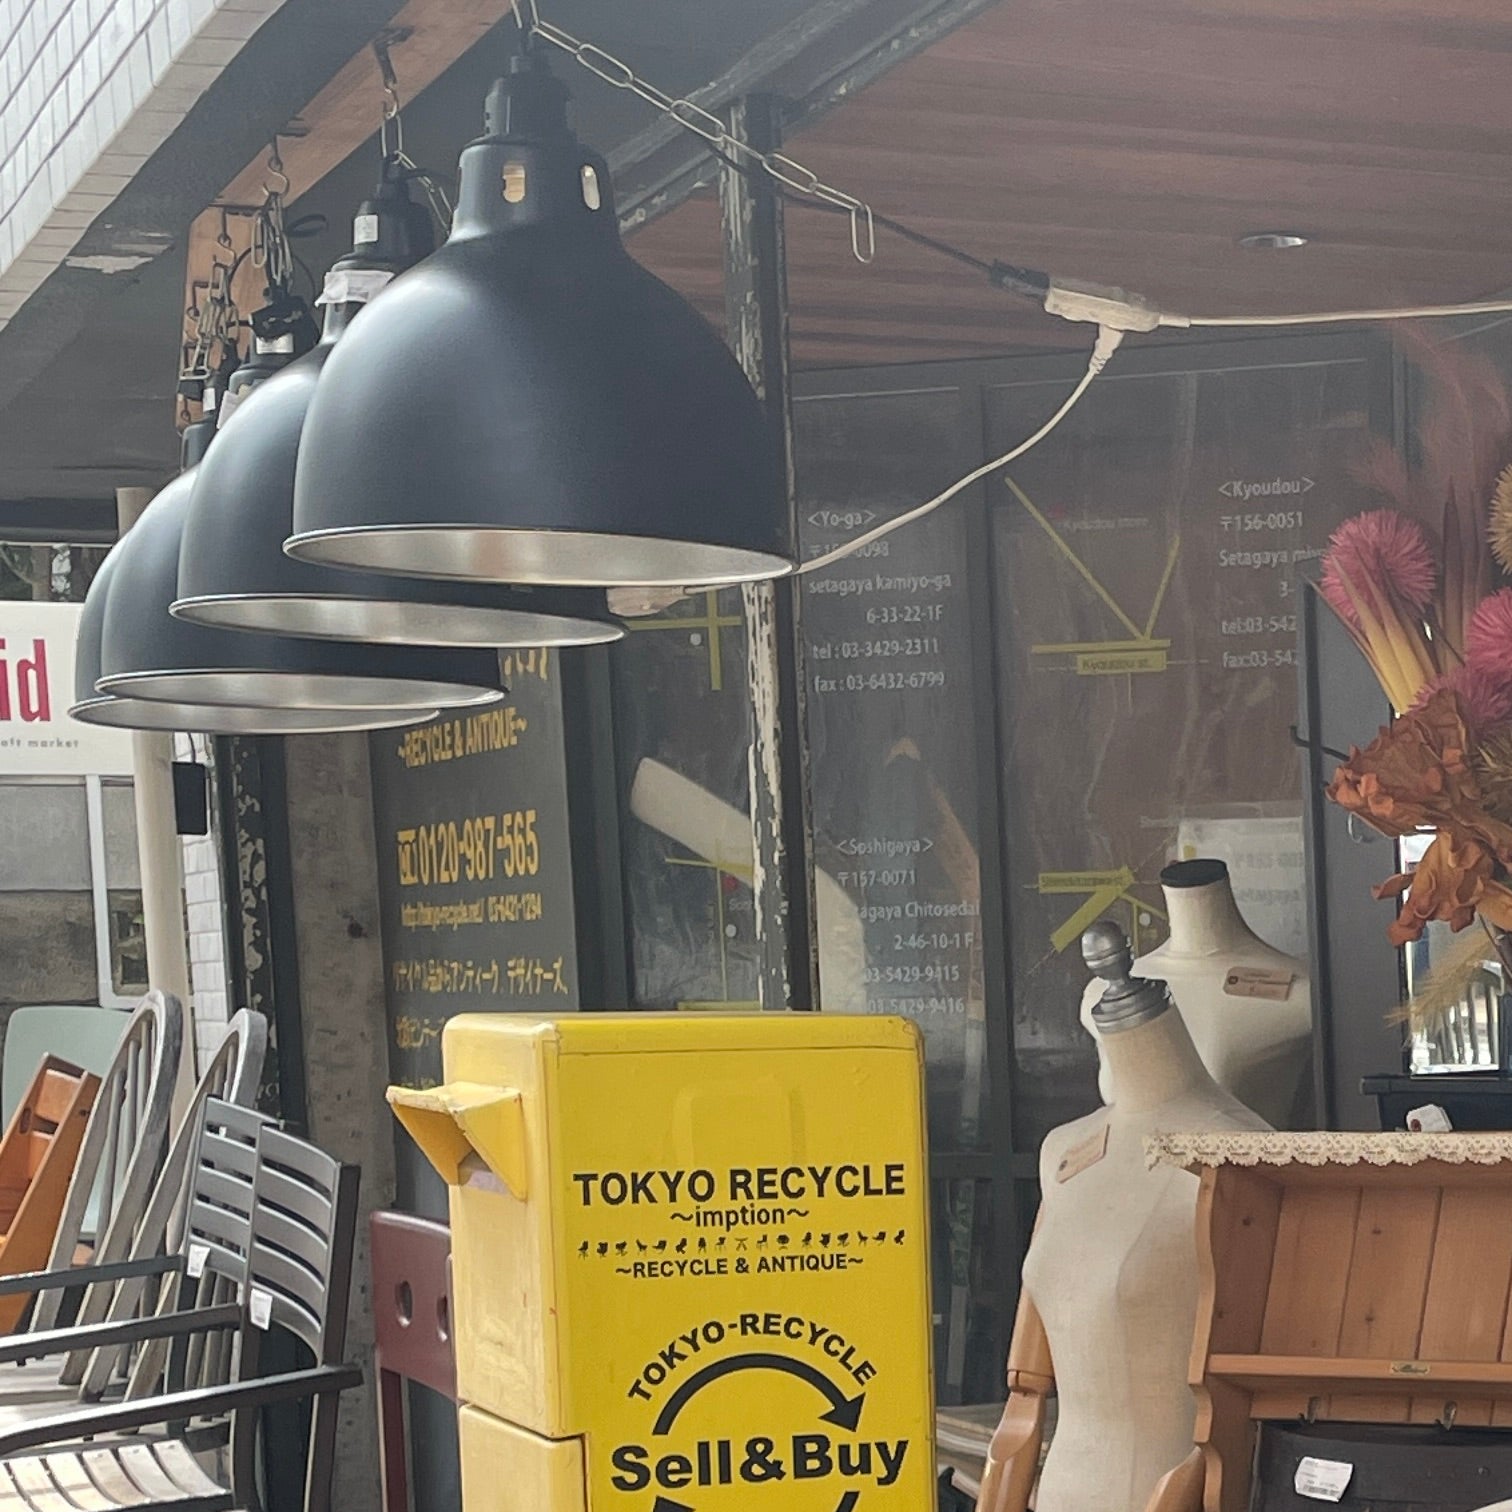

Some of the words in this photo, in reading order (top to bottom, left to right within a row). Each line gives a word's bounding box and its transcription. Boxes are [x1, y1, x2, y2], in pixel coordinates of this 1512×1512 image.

[809, 577, 872, 595] setagaya
[866, 605, 943, 623] 6-33-22-1F
[28, 737, 79, 748] market
[573, 1169, 715, 1206] TOKYO
[729, 1163, 905, 1201] RECYCLE
[735, 1257, 750, 1274] &
[628, 1313, 878, 1402] TOKYO-RECYCLE
[611, 1434, 909, 1492] Sell&Buy
